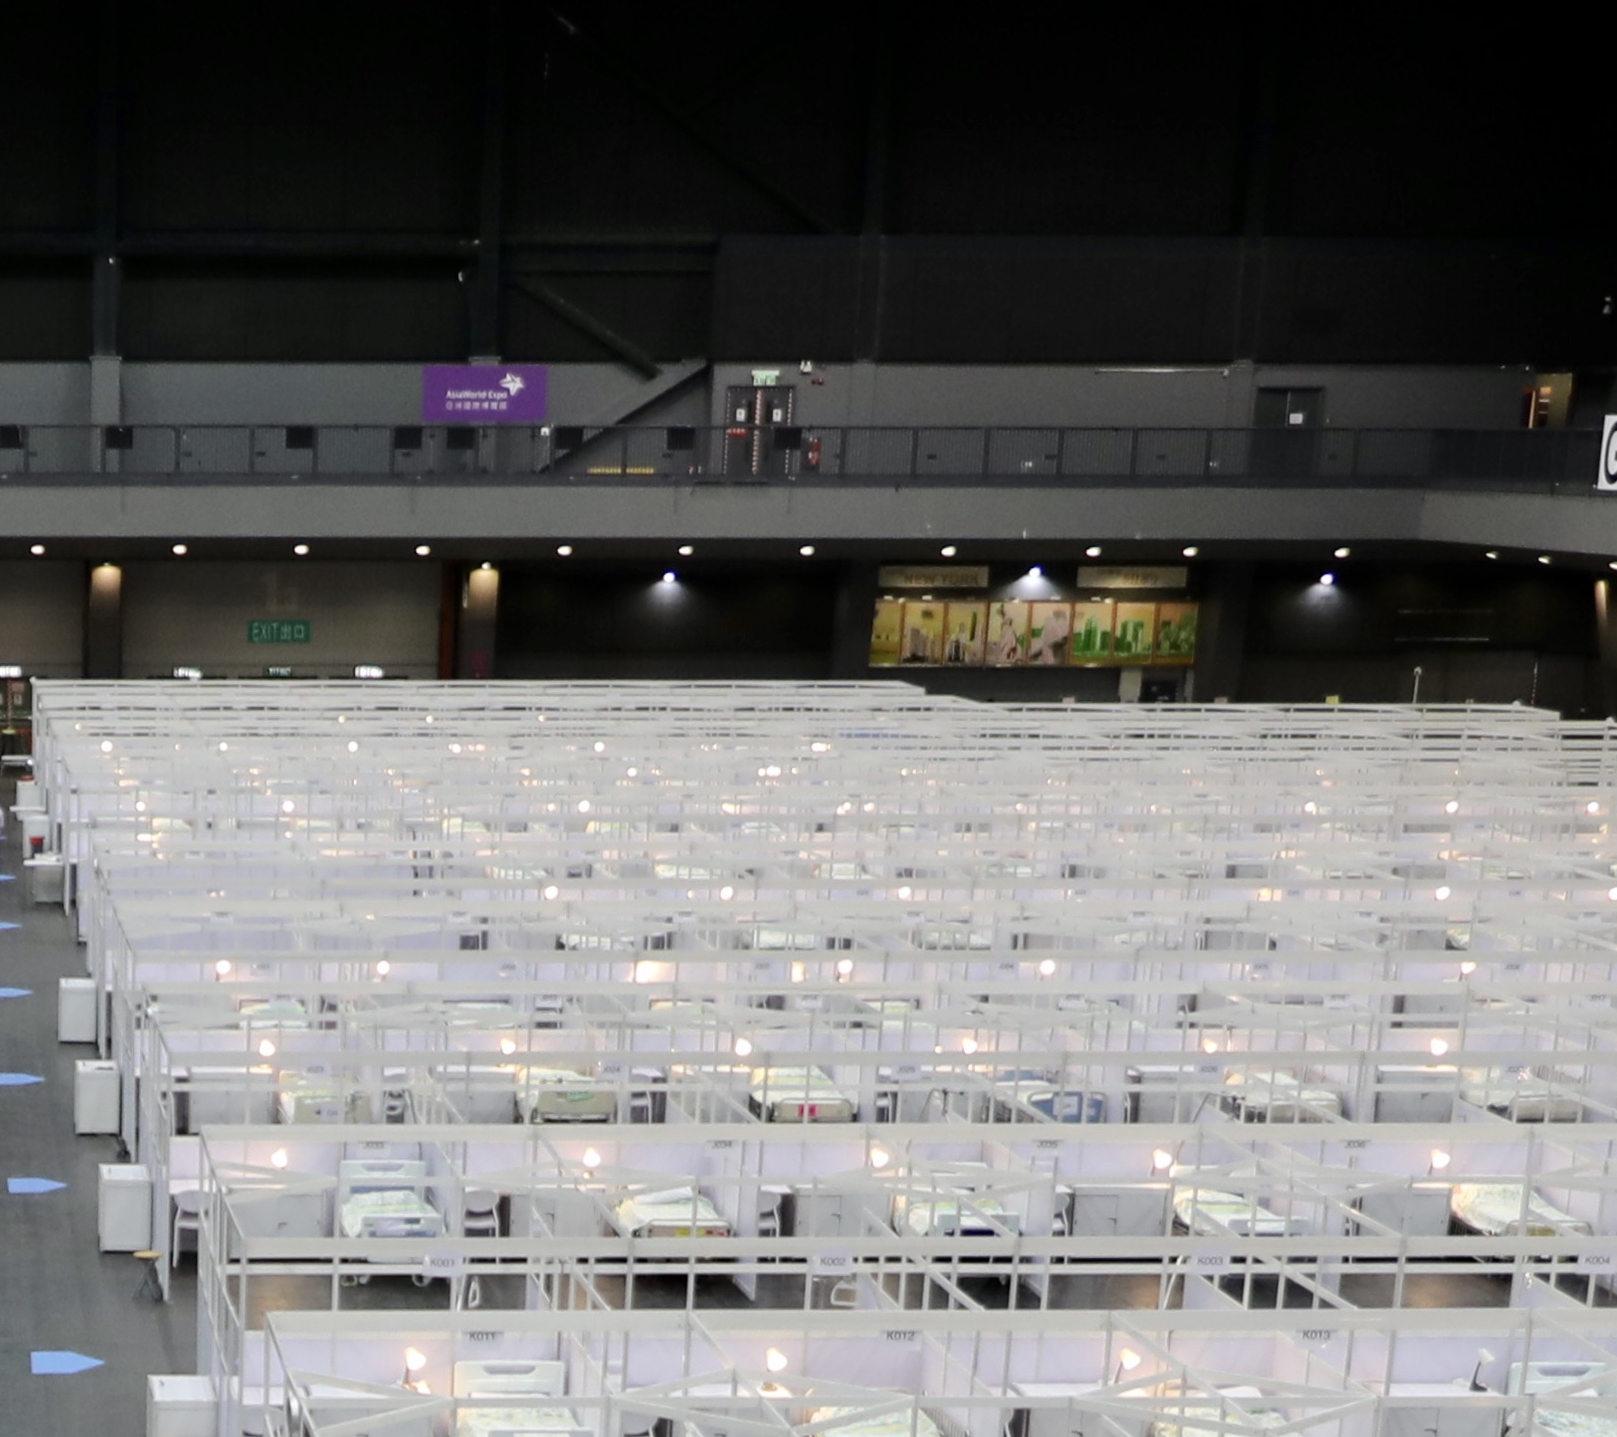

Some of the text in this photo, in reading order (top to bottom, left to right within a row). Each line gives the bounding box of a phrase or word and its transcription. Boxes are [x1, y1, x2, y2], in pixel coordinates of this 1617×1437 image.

[446, 390, 508, 400] AsiaWorld-Expo
[252, 622, 305, 640] EXIT 出口
[430, 1258, 454, 1268] K001
[819, 1257, 845, 1267] K002
[1198, 1256, 1223, 1265] K003
[1585, 1256, 1610, 1266] K004
[469, 1331, 496, 1341] K011
[886, 1331, 914, 1341] K012
[1302, 1330, 1330, 1340] K013
